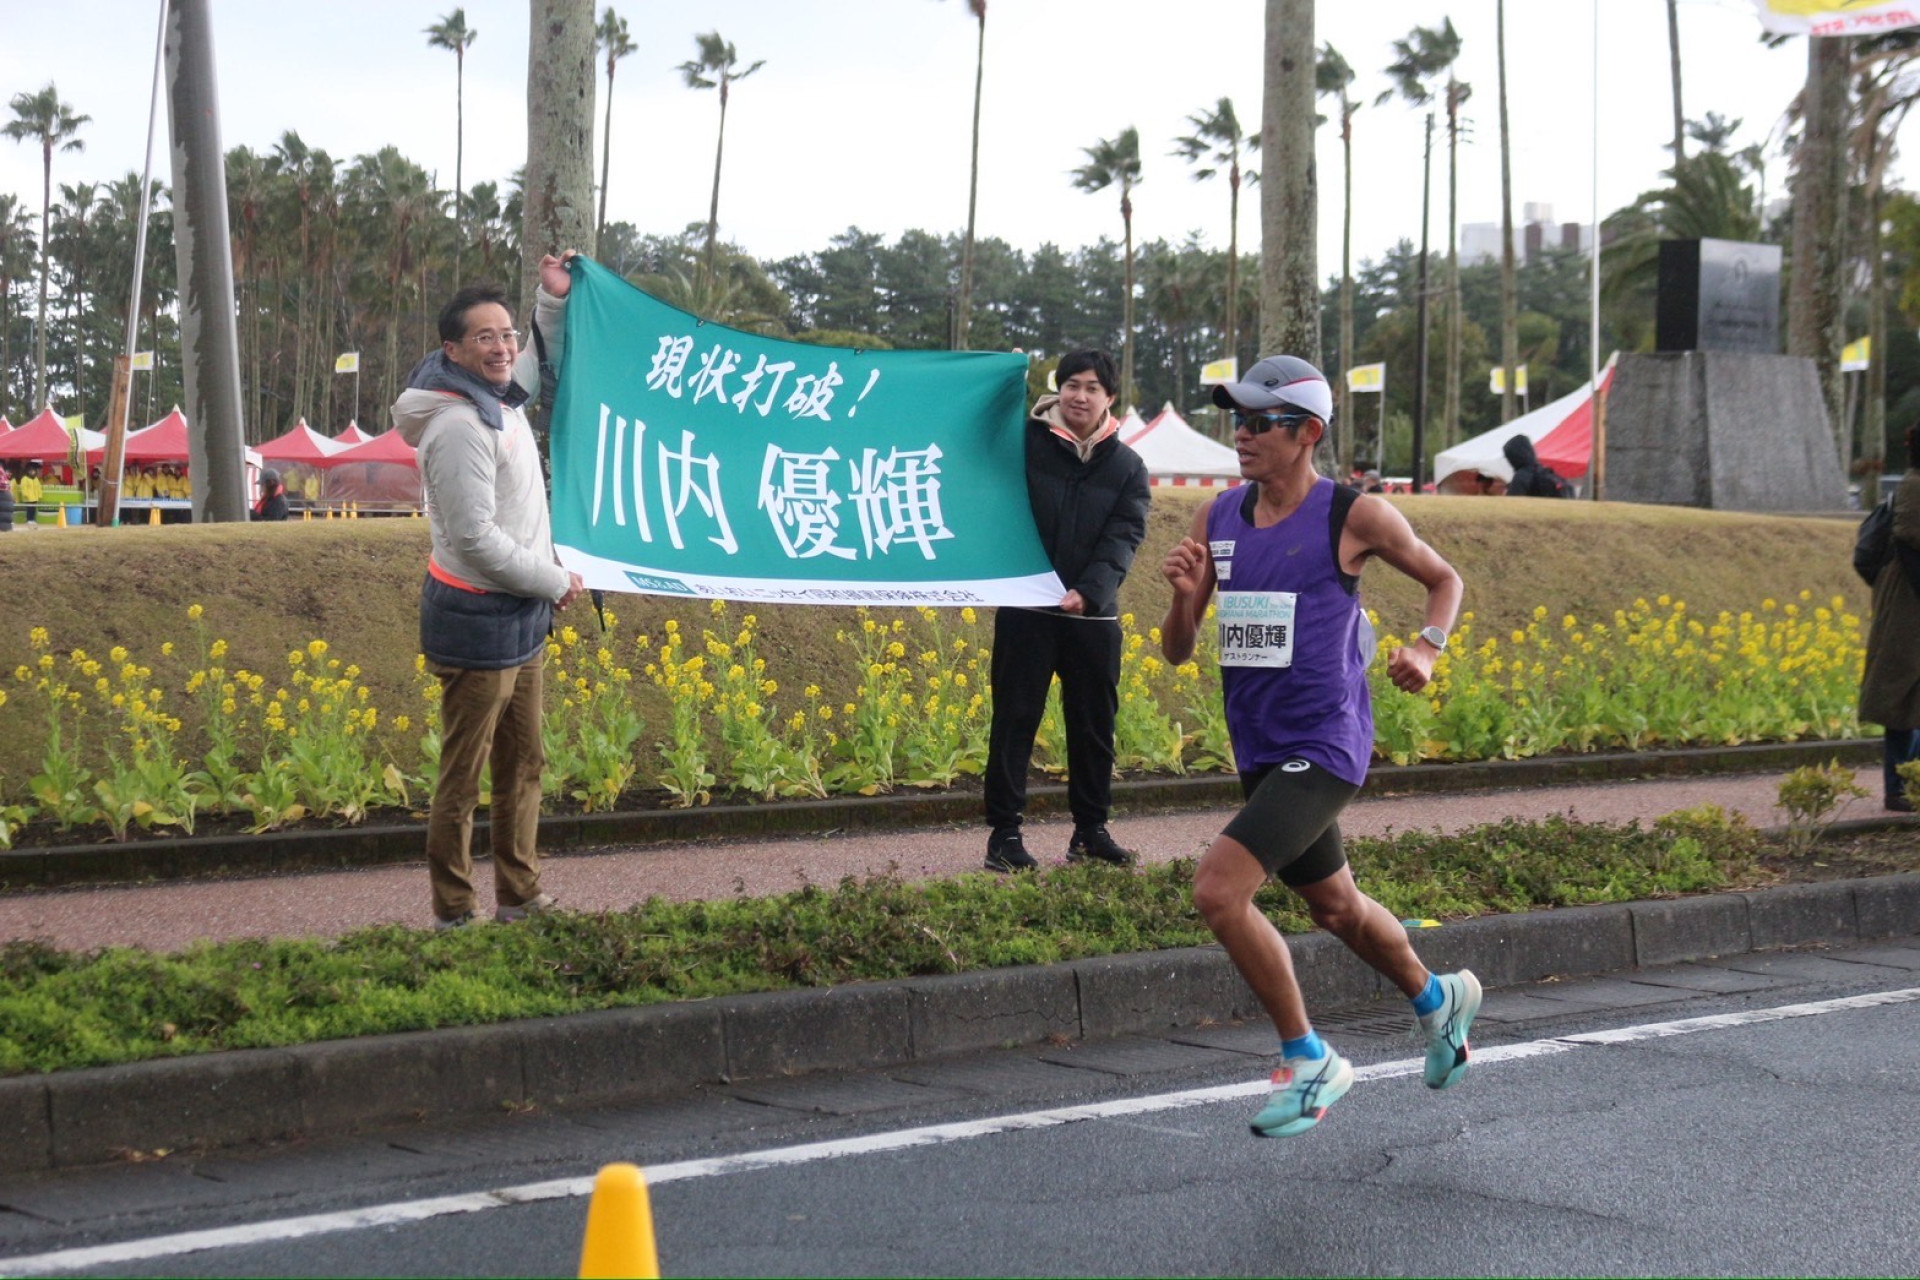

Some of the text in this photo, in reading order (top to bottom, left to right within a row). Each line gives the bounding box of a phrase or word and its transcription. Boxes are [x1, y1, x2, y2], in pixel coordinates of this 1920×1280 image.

[592, 402, 955, 561] 川内 優輝
[1223, 595, 1270, 609] IBUSUKI
